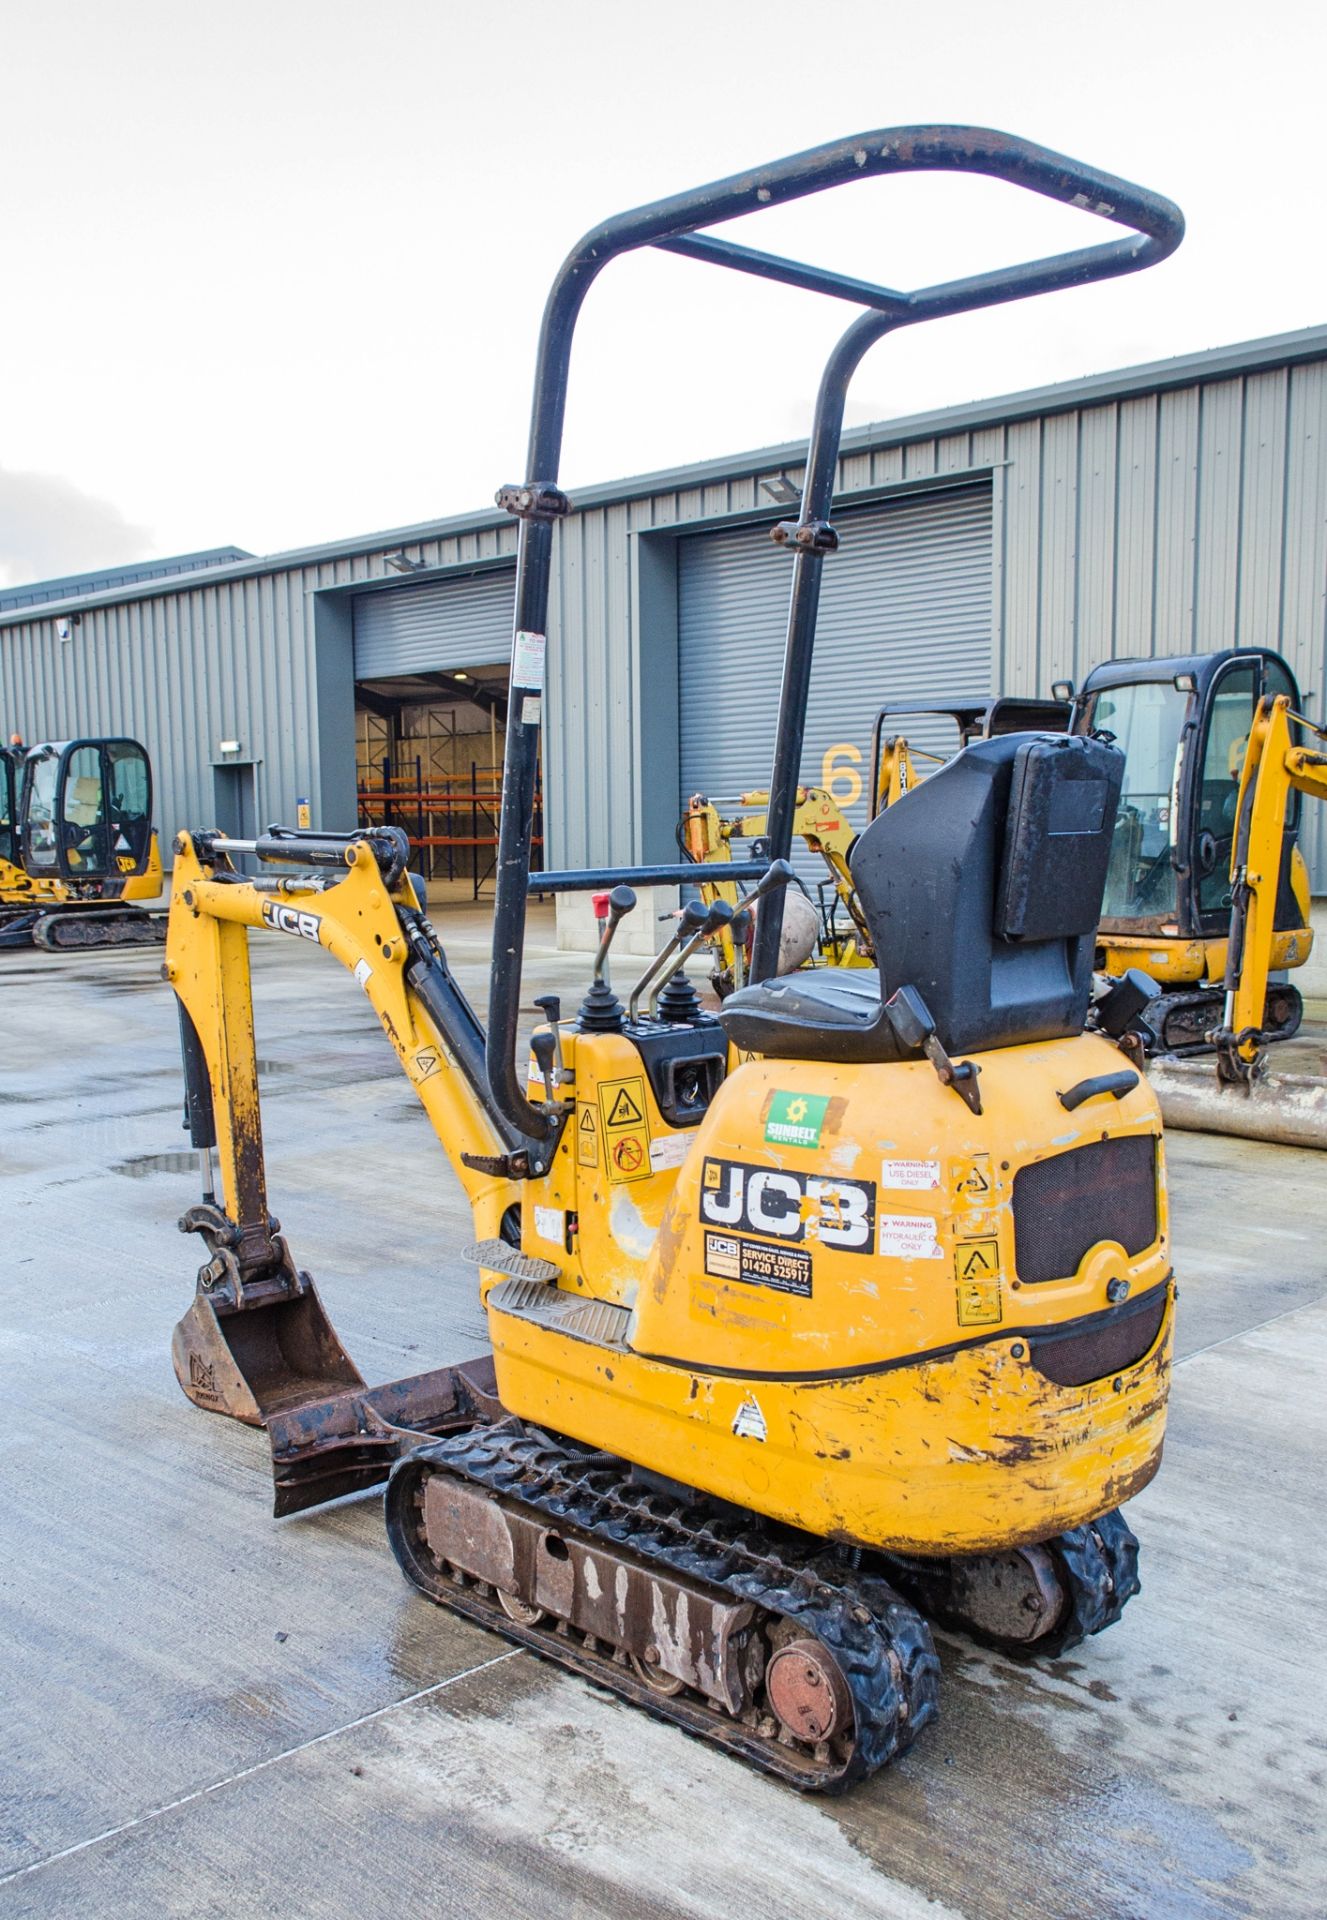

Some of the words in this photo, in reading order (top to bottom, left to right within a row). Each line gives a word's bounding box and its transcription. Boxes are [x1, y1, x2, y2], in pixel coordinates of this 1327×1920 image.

[822, 743, 863, 808] 6
[117, 857, 137, 873] JCB
[263, 905, 319, 943] JCB
[766, 1121, 818, 1141] SUNBELT
[771, 1134, 809, 1146] RENTALS
[893, 1161, 930, 1169] WARNING
[889, 1170, 906, 1178] USE
[906, 1170, 933, 1179] DIESEL
[901, 1178, 920, 1186] ONLY
[702, 1166, 870, 1248] JCB
[892, 1220, 933, 1229] WARNING
[882, 1231, 927, 1242] HYDRAULIC
[709, 1239, 738, 1255] JCB
[900, 1242, 923, 1251] ONLY
[742, 1248, 776, 1265] SERVICE
[777, 1255, 809, 1271] DIRECT
[742, 1258, 771, 1275] 01420
[773, 1264, 809, 1283] 525917
